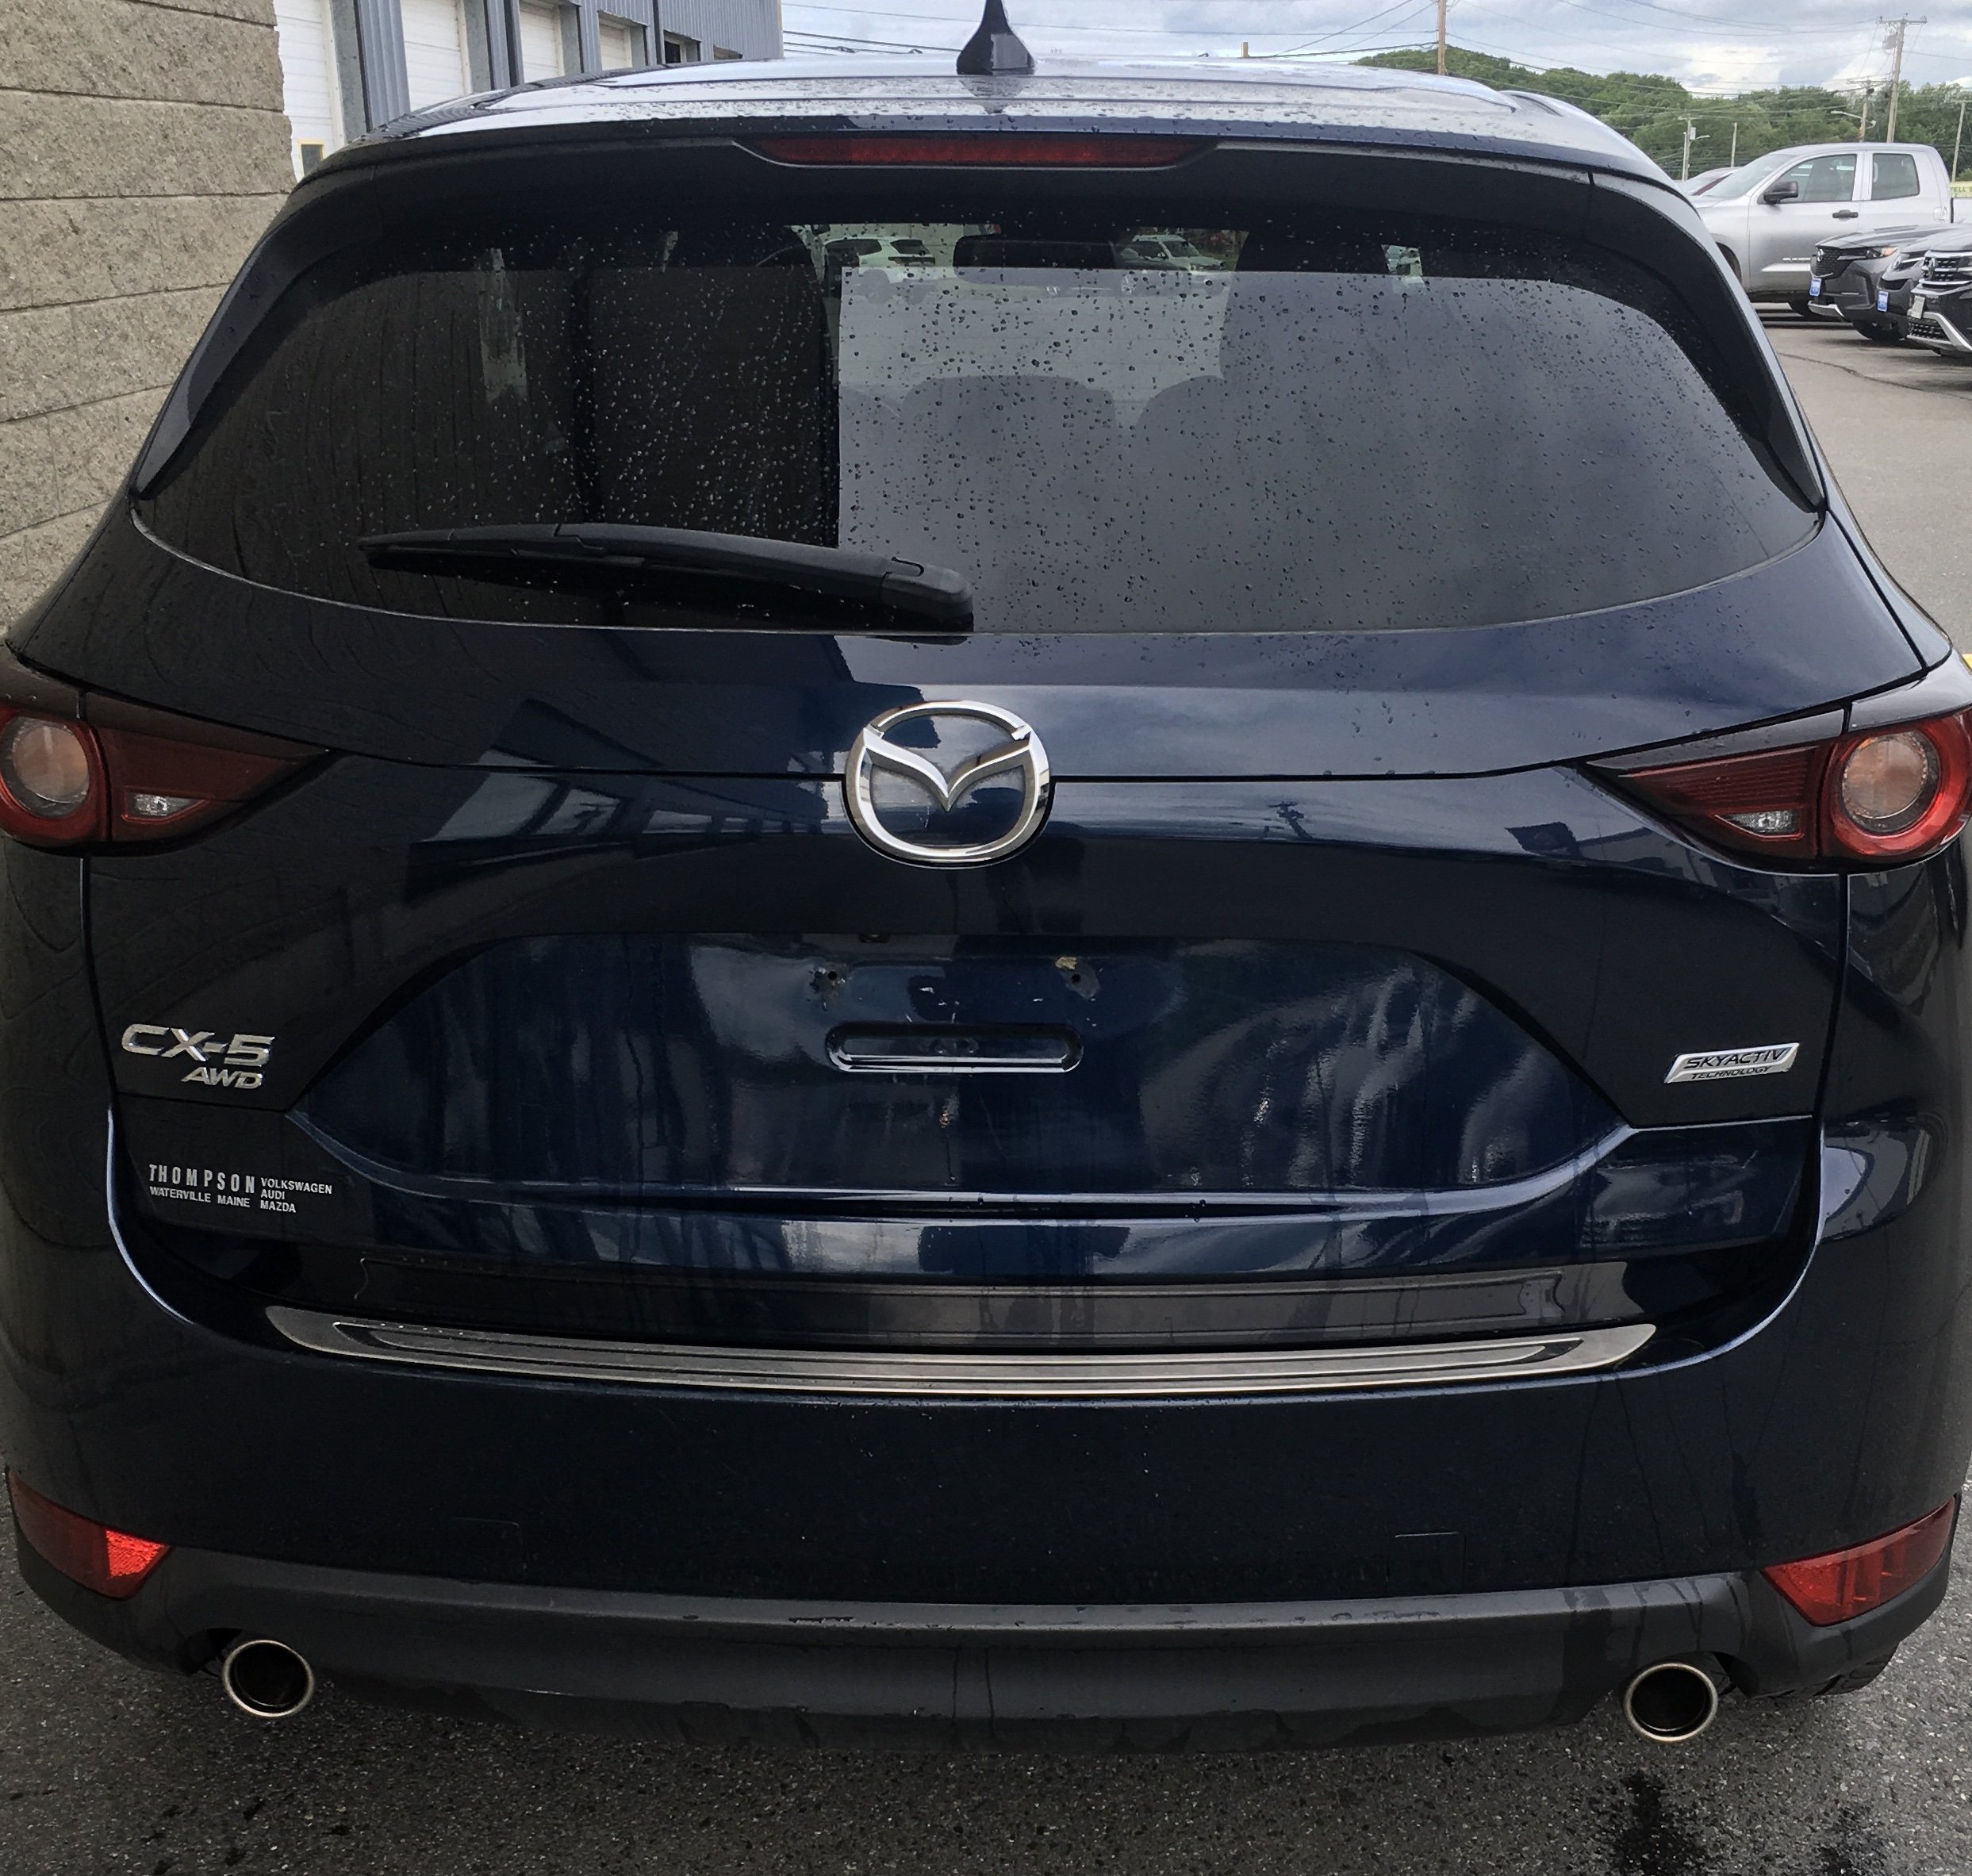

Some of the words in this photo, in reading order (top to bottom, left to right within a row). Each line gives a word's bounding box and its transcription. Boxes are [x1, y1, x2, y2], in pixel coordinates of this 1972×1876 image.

[121, 1023, 275, 1067] CX-5
[1683, 1049, 1786, 1069] SKYACTIV
[181, 1067, 263, 1089] AWD
[1691, 1066, 1771, 1080] TECHNOLOGY
[149, 1164, 255, 1193] THOMPSON
[260, 1177, 332, 1194] VOLKSWAGEN
[149, 1186, 212, 1203] WATERVILLE
[217, 1195, 251, 1207] MAINE
[260, 1189, 285, 1199] AUDI
[260, 1200, 297, 1213] MAZDA
